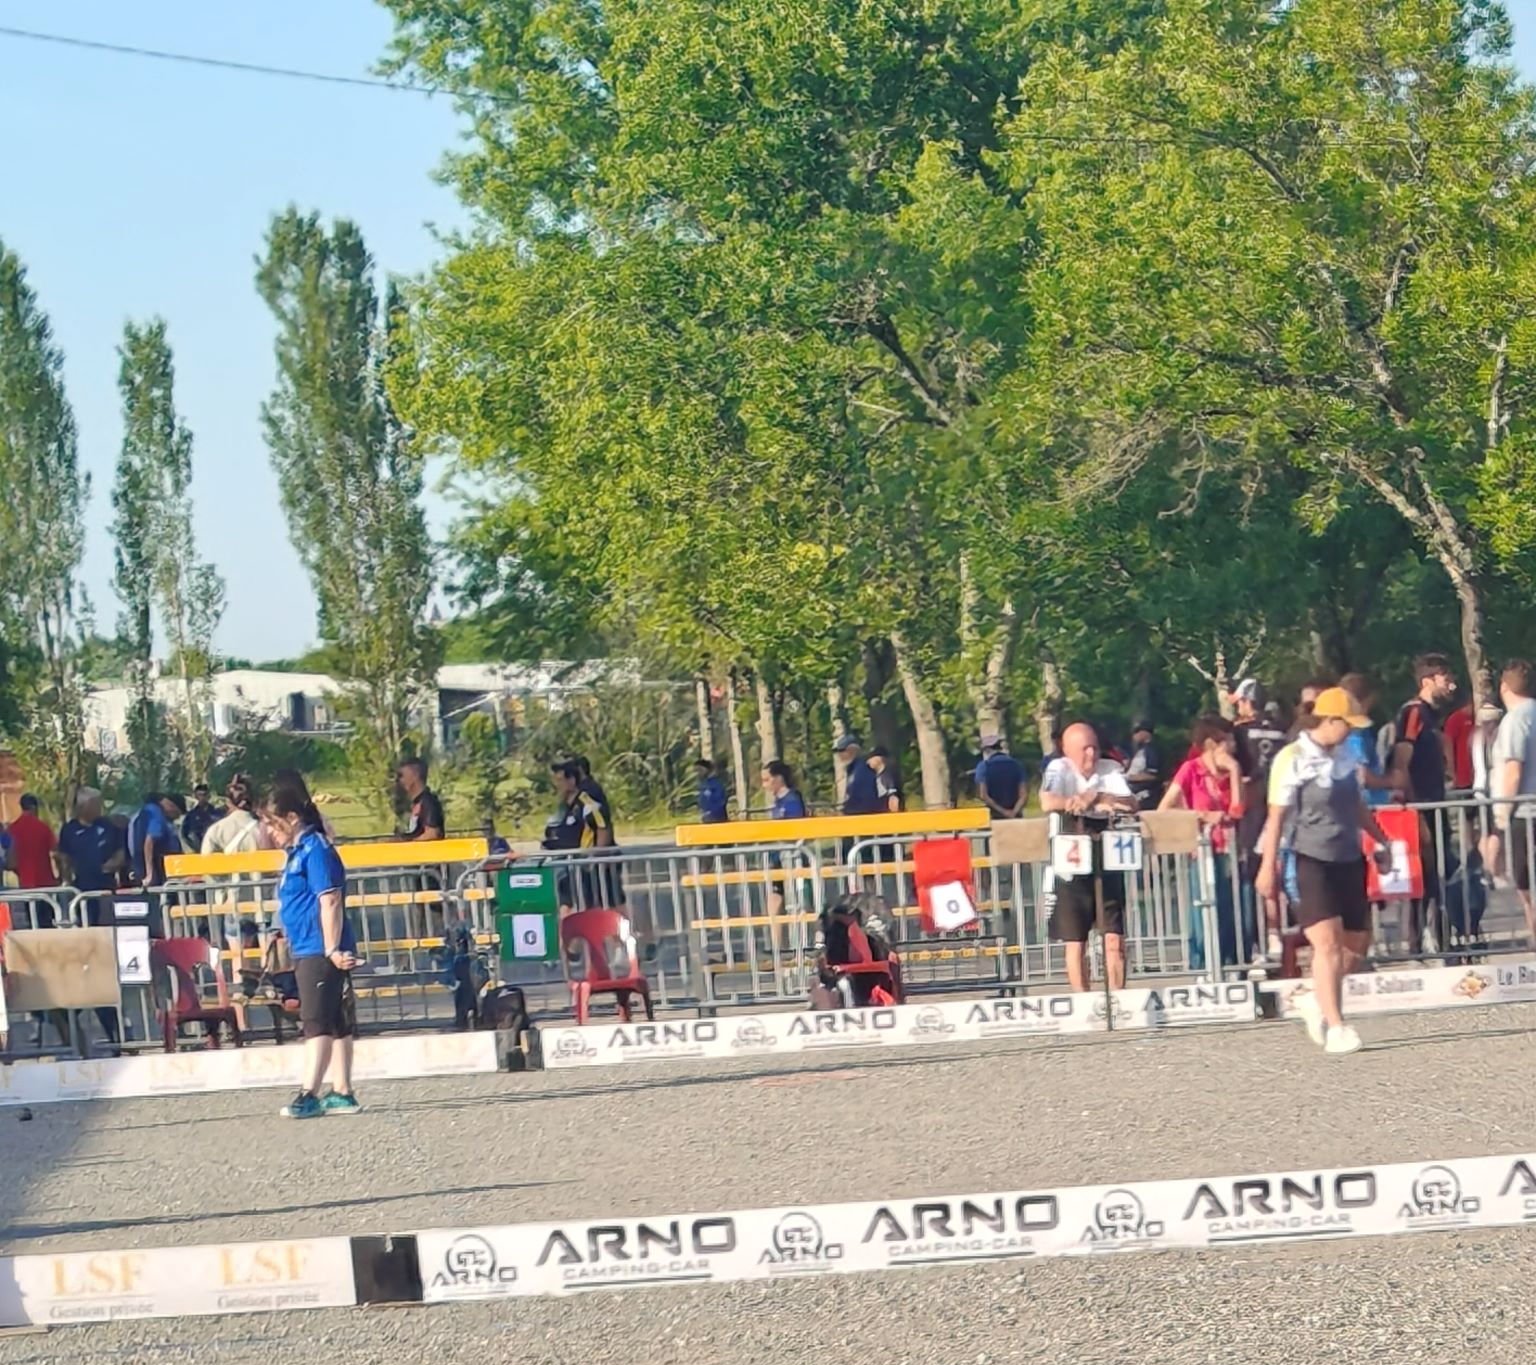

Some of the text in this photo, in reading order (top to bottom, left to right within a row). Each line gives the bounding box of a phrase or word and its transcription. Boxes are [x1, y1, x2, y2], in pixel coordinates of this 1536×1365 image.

[1066, 839, 1081, 868] 4
[1113, 836, 1136, 865] 11
[127, 956, 140, 973] 4
[965, 997, 1073, 1024] ARNO
[1143, 984, 1249, 1011] ARNO
[607, 1021, 718, 1048] ARNO
[787, 1010, 896, 1036] ARNO
[1182, 1171, 1377, 1221] ARNO
[862, 1195, 1059, 1244] ARNO
[536, 1217, 736, 1267] ARNO
[888, 1235, 1033, 1257] CAMPING-CAR
[53, 1253, 146, 1296] LSF
[218, 1243, 313, 1286] LSF
[563, 1258, 711, 1280] CAMPING-CAR
